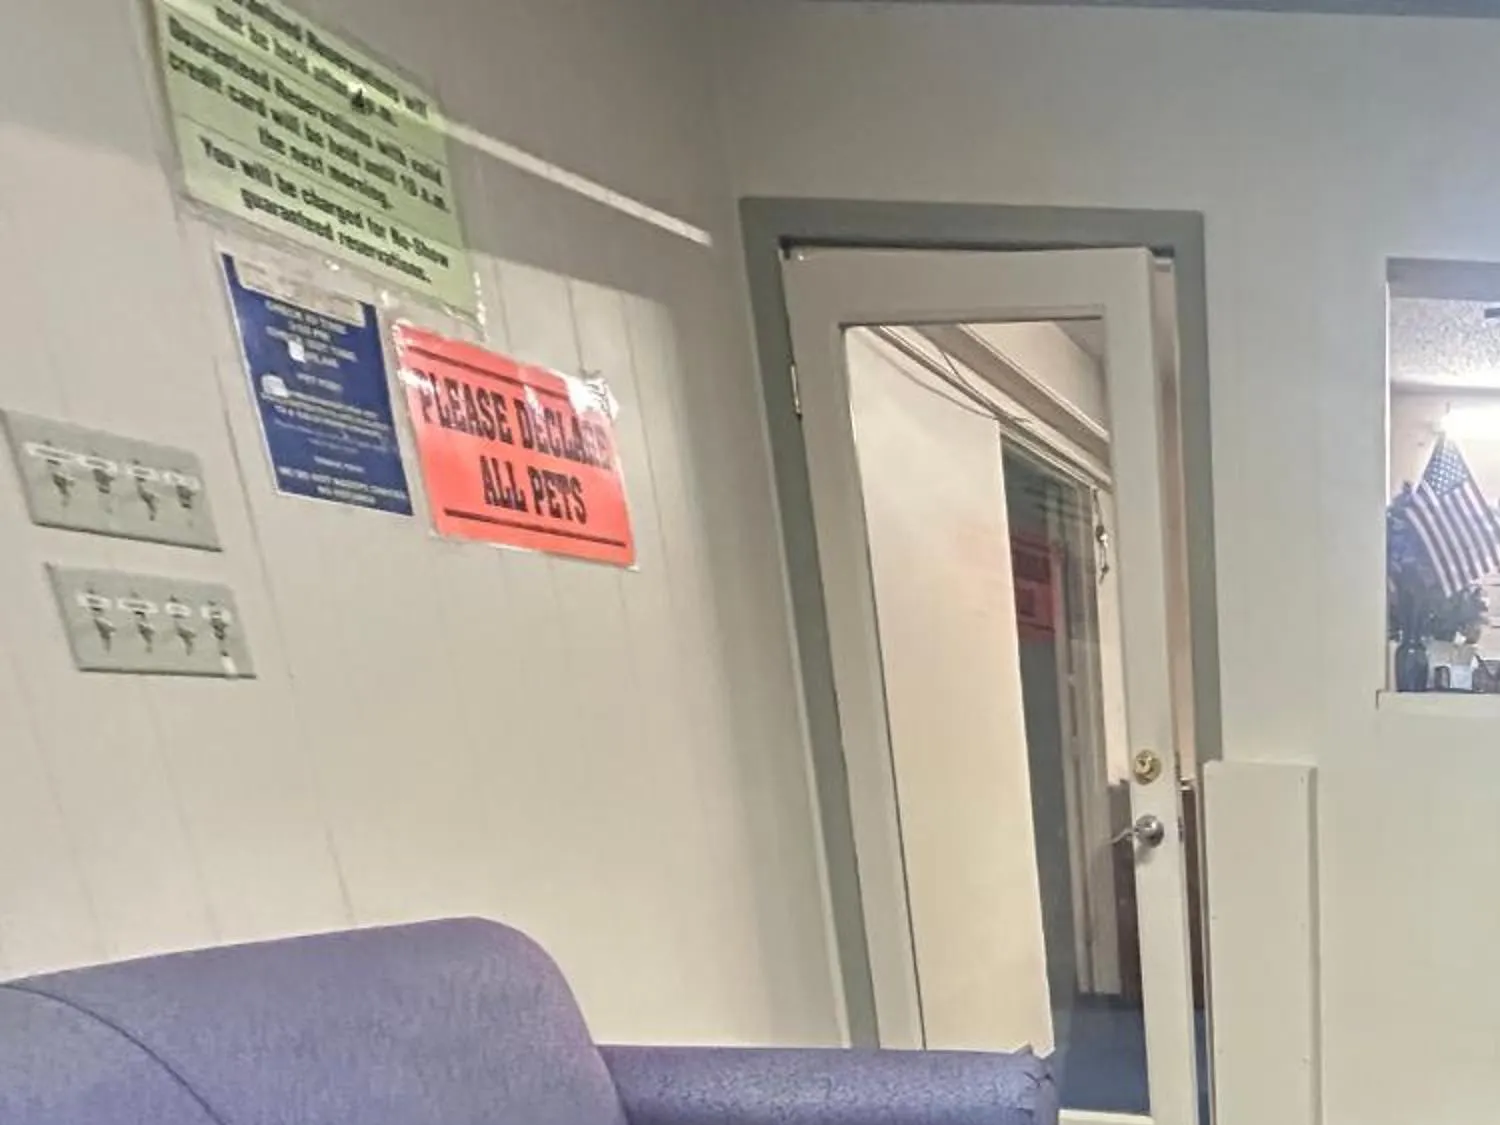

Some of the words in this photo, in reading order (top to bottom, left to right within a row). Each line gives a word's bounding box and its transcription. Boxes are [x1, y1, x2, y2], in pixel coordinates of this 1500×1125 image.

[303, 122, 325, 149] be
[241, 187, 335, 241] guaranteed
[274, 172, 299, 199] be
[301, 187, 364, 229] charged
[411, 367, 514, 446] PLEASE
[513, 397, 612, 471] DECLARE
[480, 455, 528, 513] ALL
[527, 465, 587, 525] PETS
